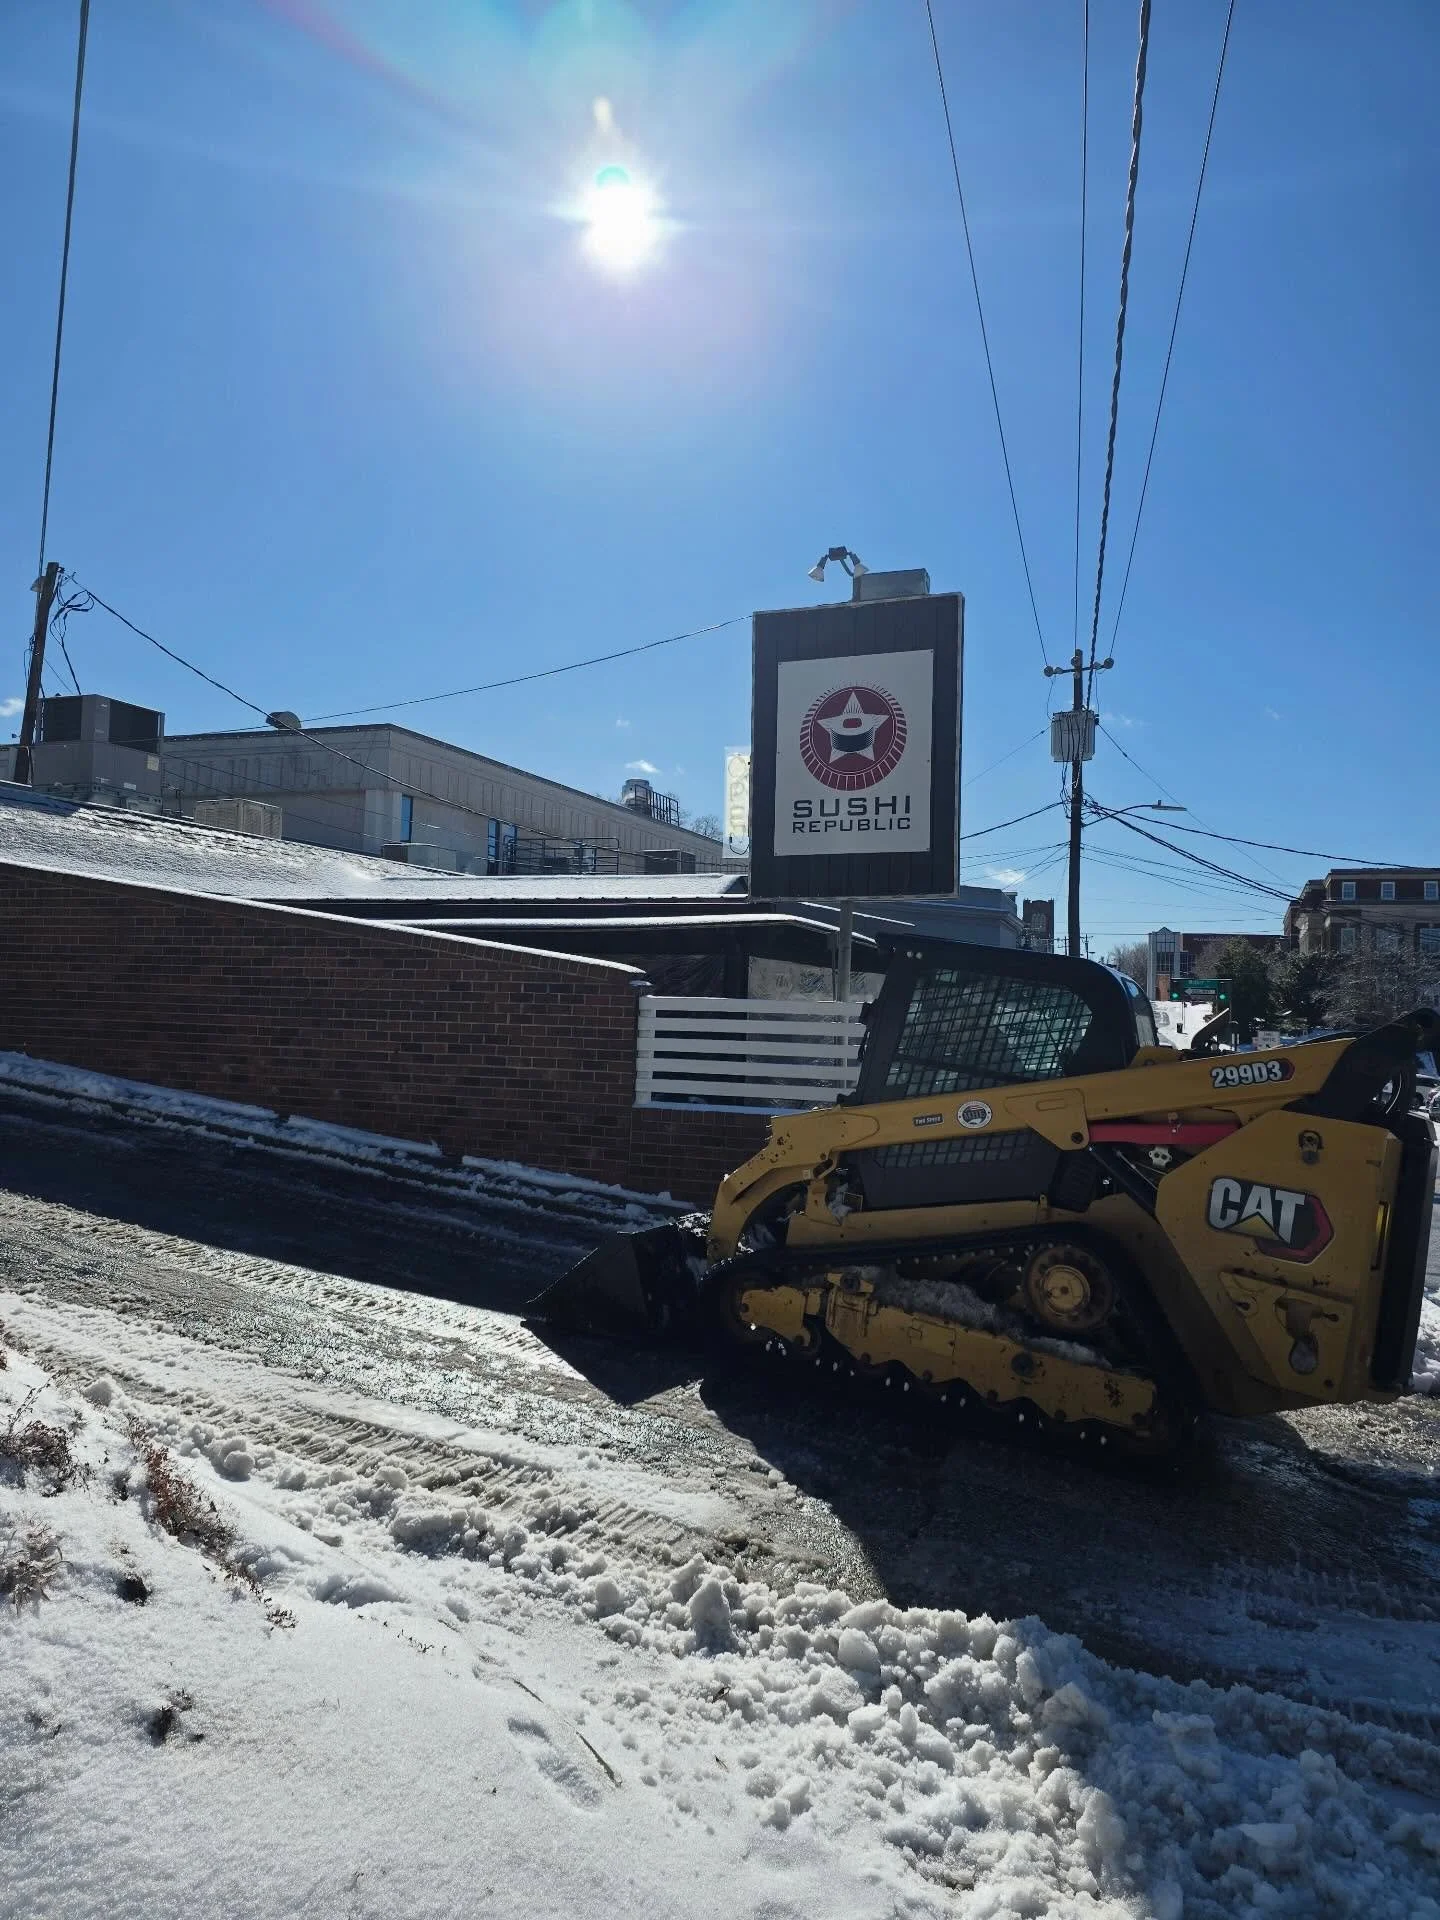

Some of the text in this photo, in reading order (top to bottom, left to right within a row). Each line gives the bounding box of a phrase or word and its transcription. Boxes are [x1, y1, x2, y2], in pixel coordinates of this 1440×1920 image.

[793, 796, 910, 818] SUSHI
[793, 818, 910, 833] REPUBLIC
[1212, 1061, 1282, 1087] 299D3
[1209, 1178, 1305, 1244] CAT
